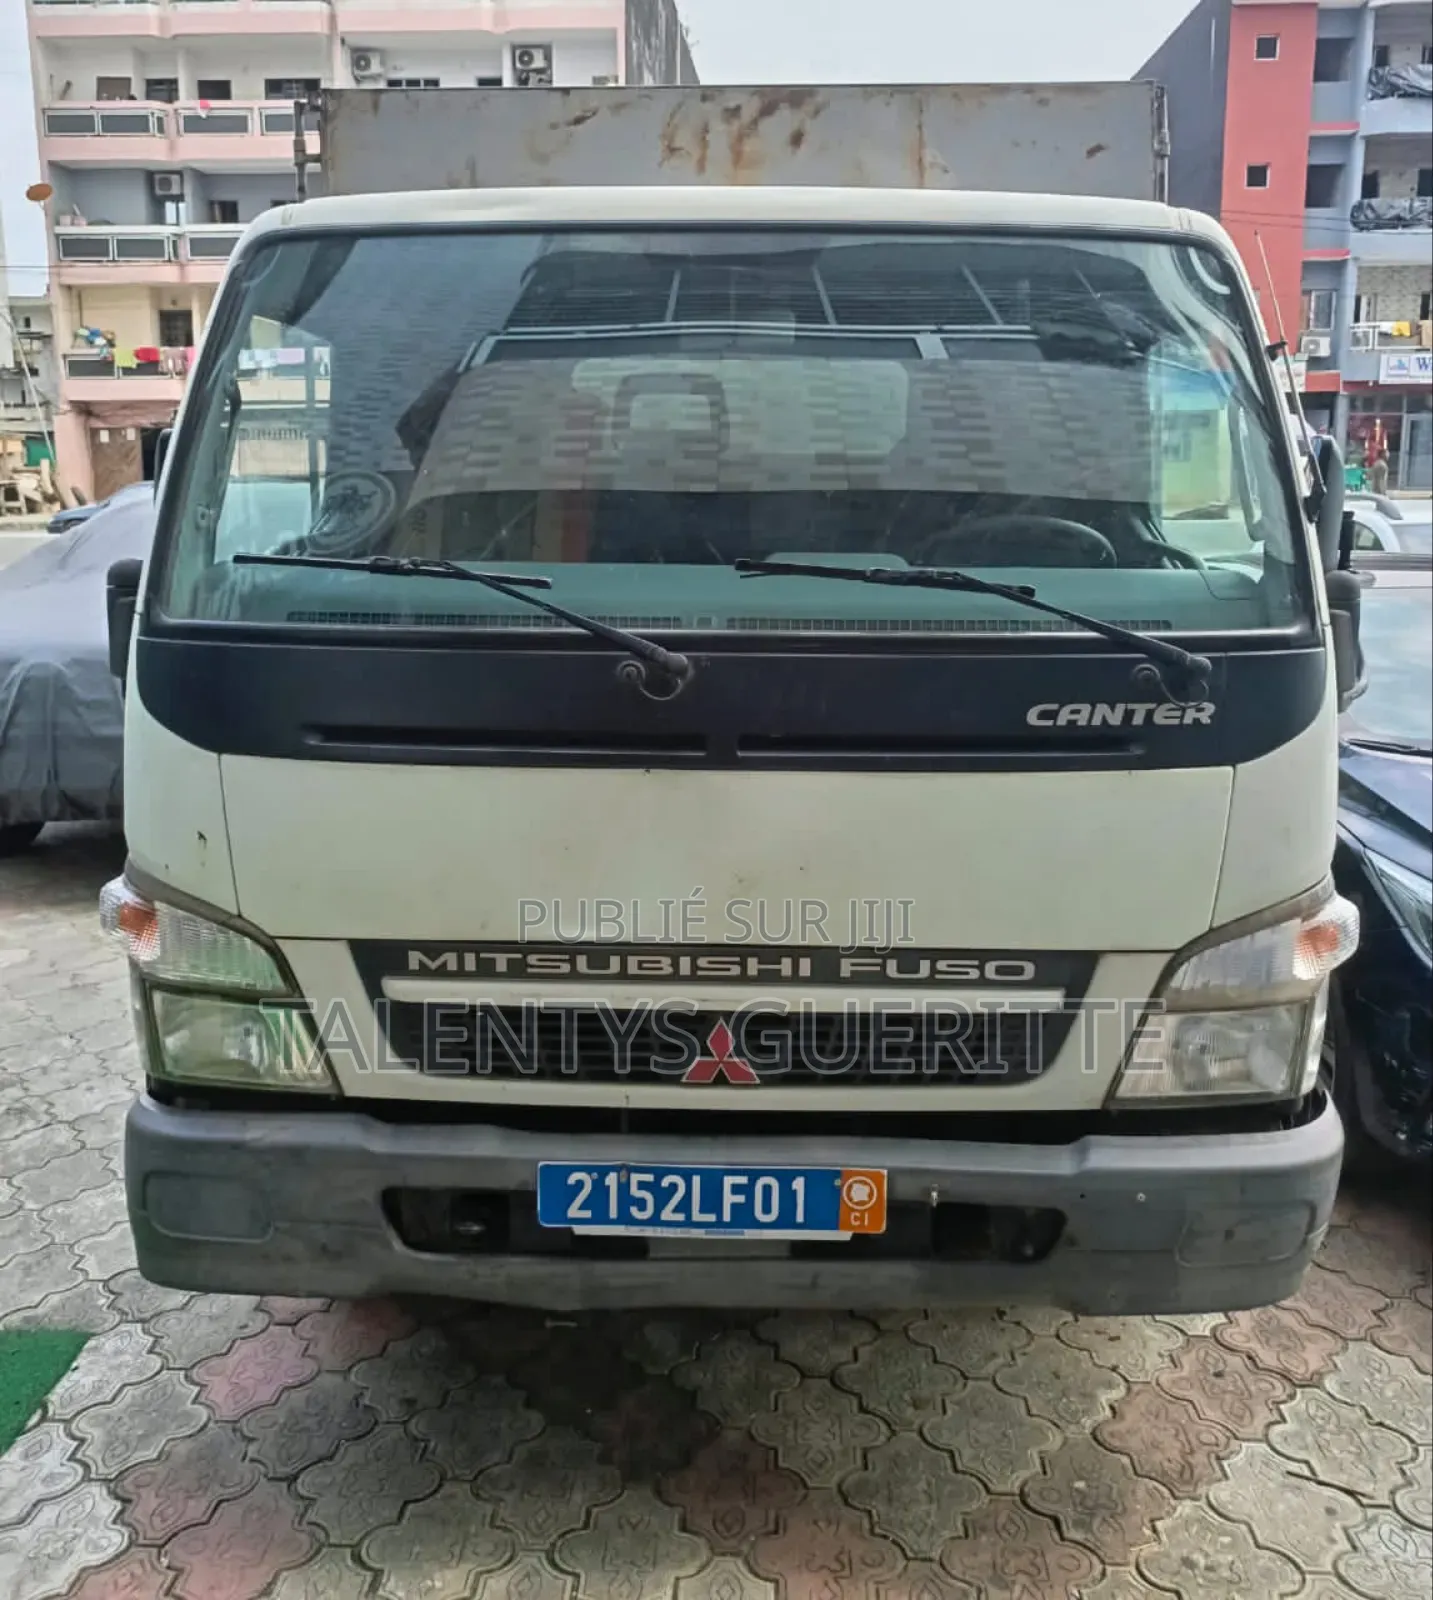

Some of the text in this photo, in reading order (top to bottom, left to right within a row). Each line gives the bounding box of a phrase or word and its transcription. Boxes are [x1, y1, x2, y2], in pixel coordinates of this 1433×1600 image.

[1026, 702, 1216, 726] CANTER
[407, 950, 1036, 981] MITSUBISHI FUSO
[566, 1172, 806, 1223] 2152LF01
[850, 1211, 869, 1227] CI
